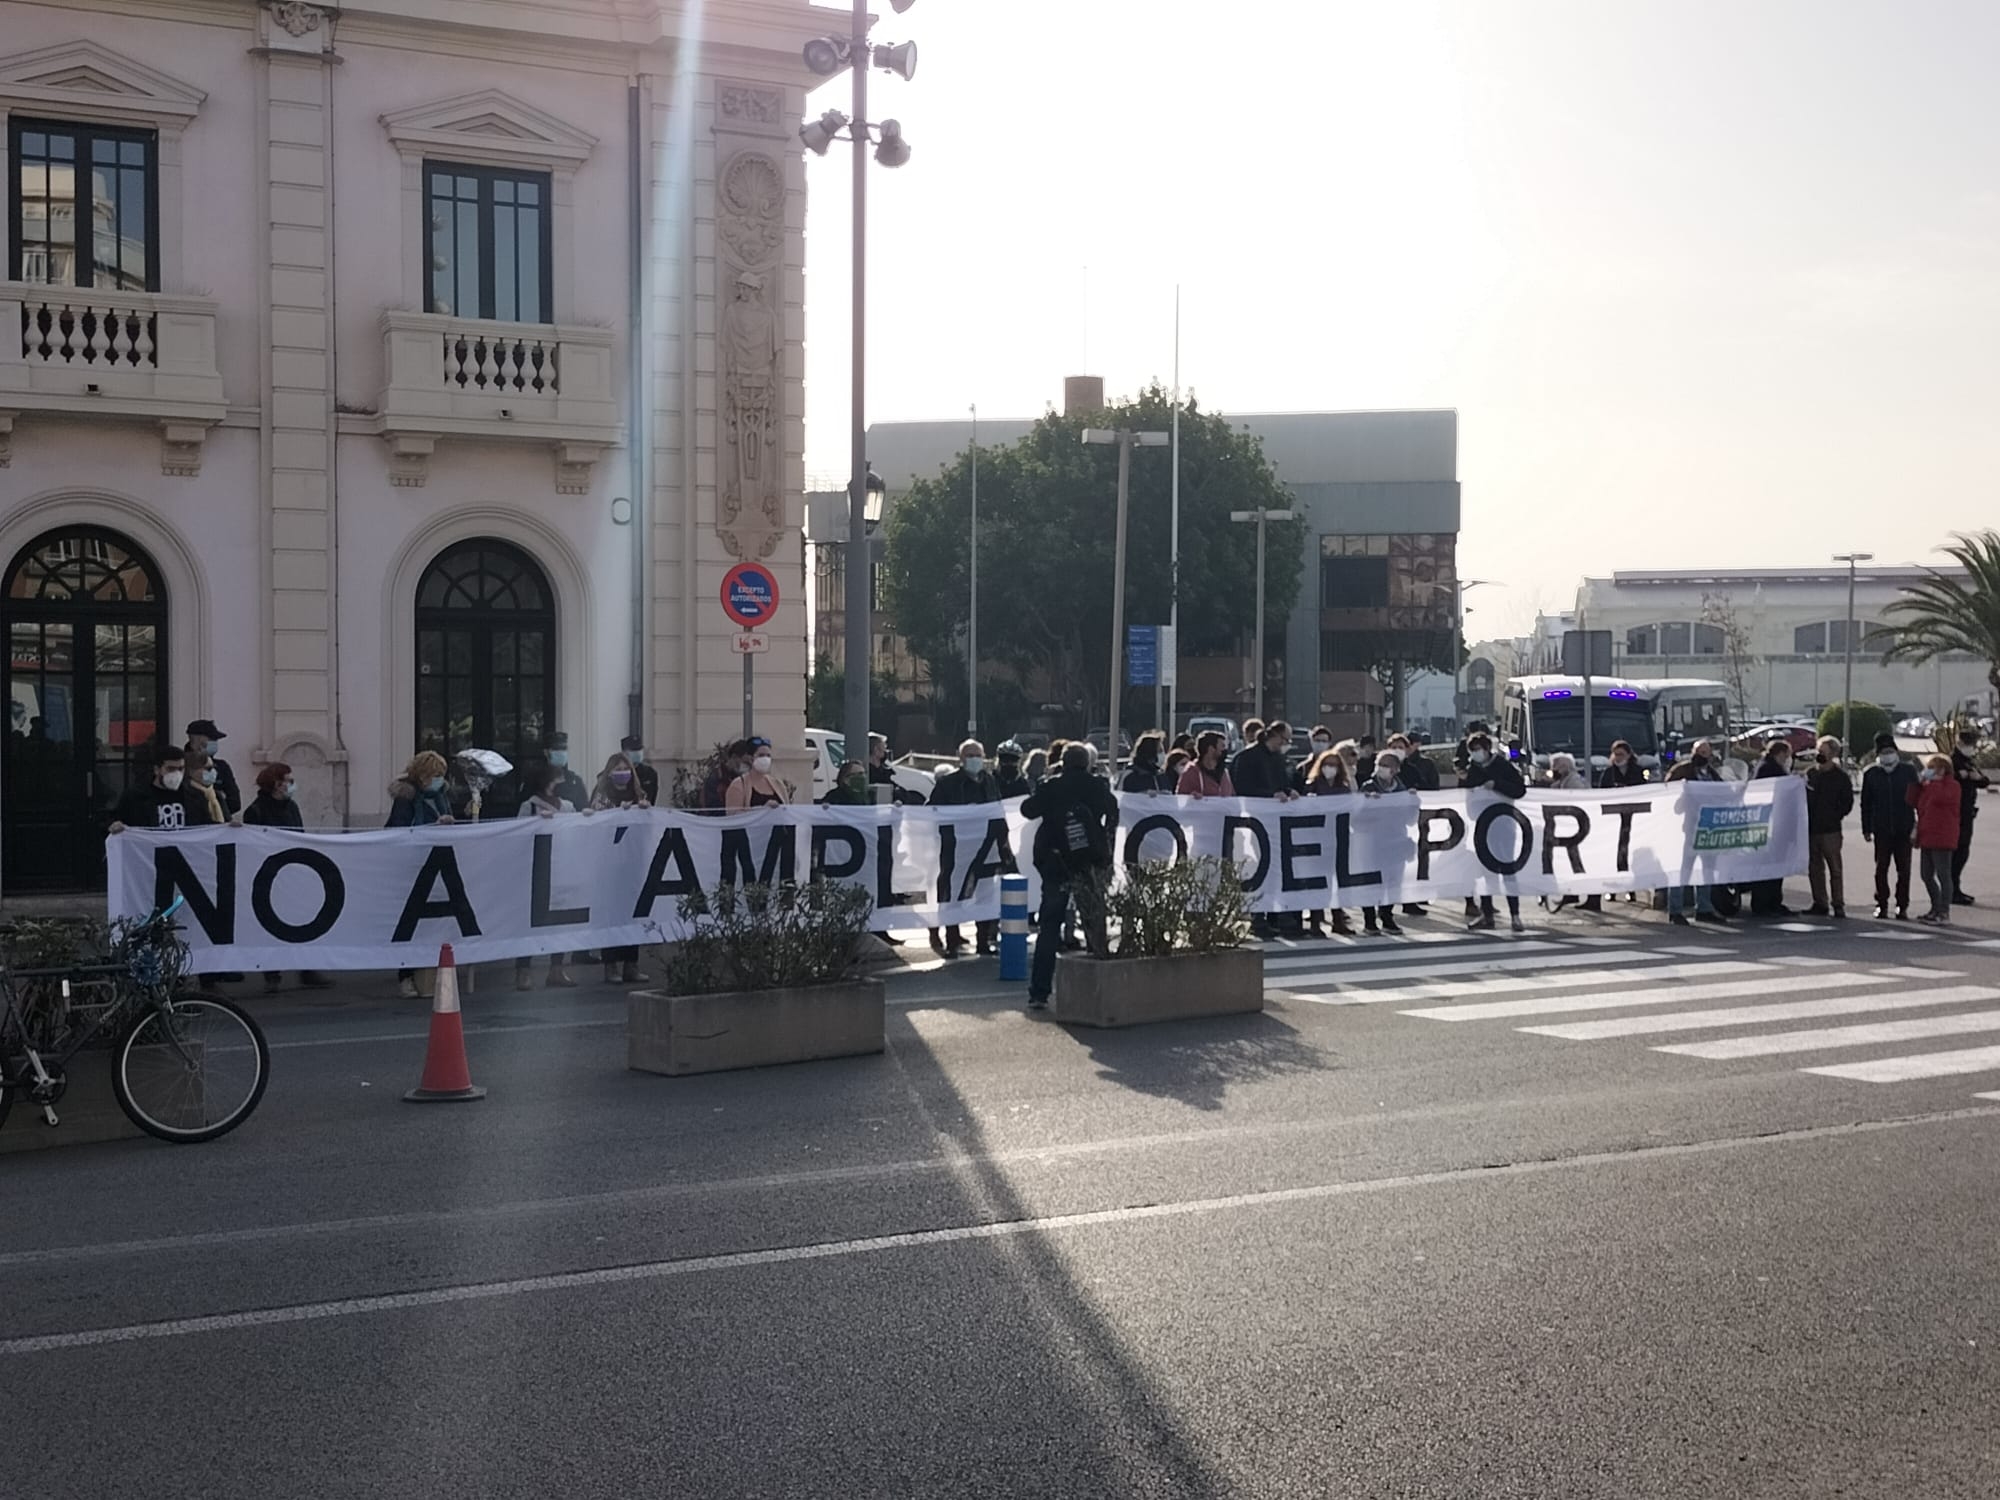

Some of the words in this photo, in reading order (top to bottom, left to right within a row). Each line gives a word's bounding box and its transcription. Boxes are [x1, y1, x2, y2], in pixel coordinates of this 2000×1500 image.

[737, 586, 765, 594] EXCEPTO
[730, 594, 772, 603] AUTORIZADOS
[154, 843, 345, 945] NO
[391, 846, 482, 942] A
[530, 814, 1188, 927] L'AMPLIAO
[1223, 812, 1382, 892] DEL
[1417, 802, 1652, 882] PORT
